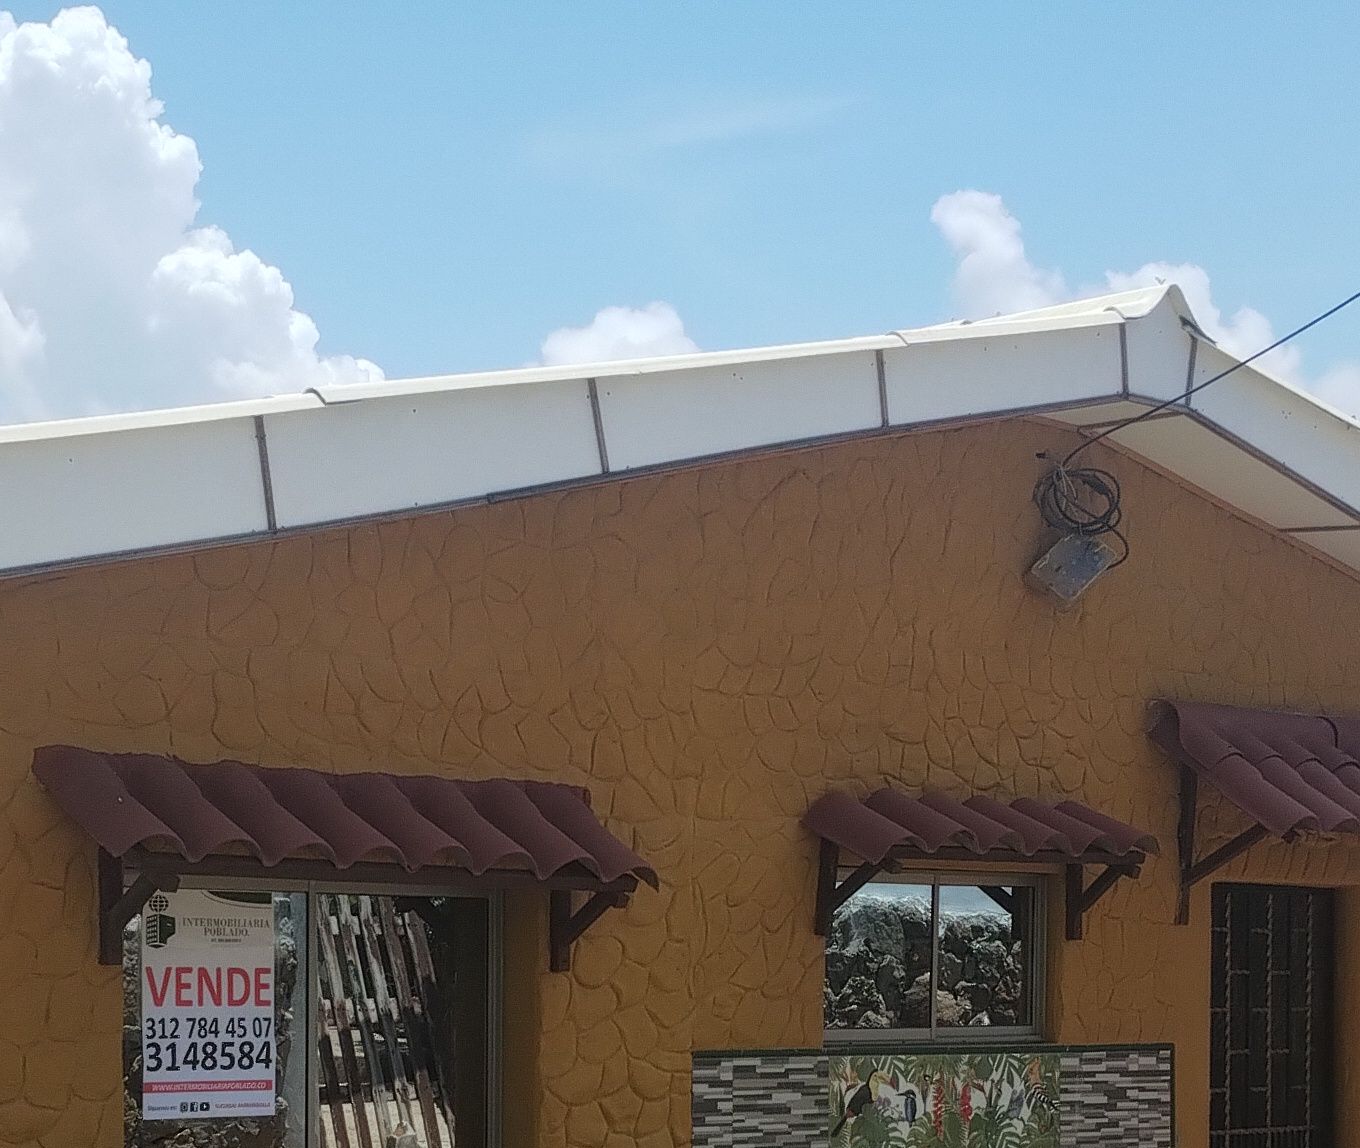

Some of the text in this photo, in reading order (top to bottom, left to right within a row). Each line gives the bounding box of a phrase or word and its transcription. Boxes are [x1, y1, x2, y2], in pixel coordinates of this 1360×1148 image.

[182, 917, 270, 928] INTERMOBILIARIA
[145, 966, 272, 1007] VENDE
[145, 1017, 272, 1039] 312 784 45 07
[146, 1041, 272, 1072] 3148584
